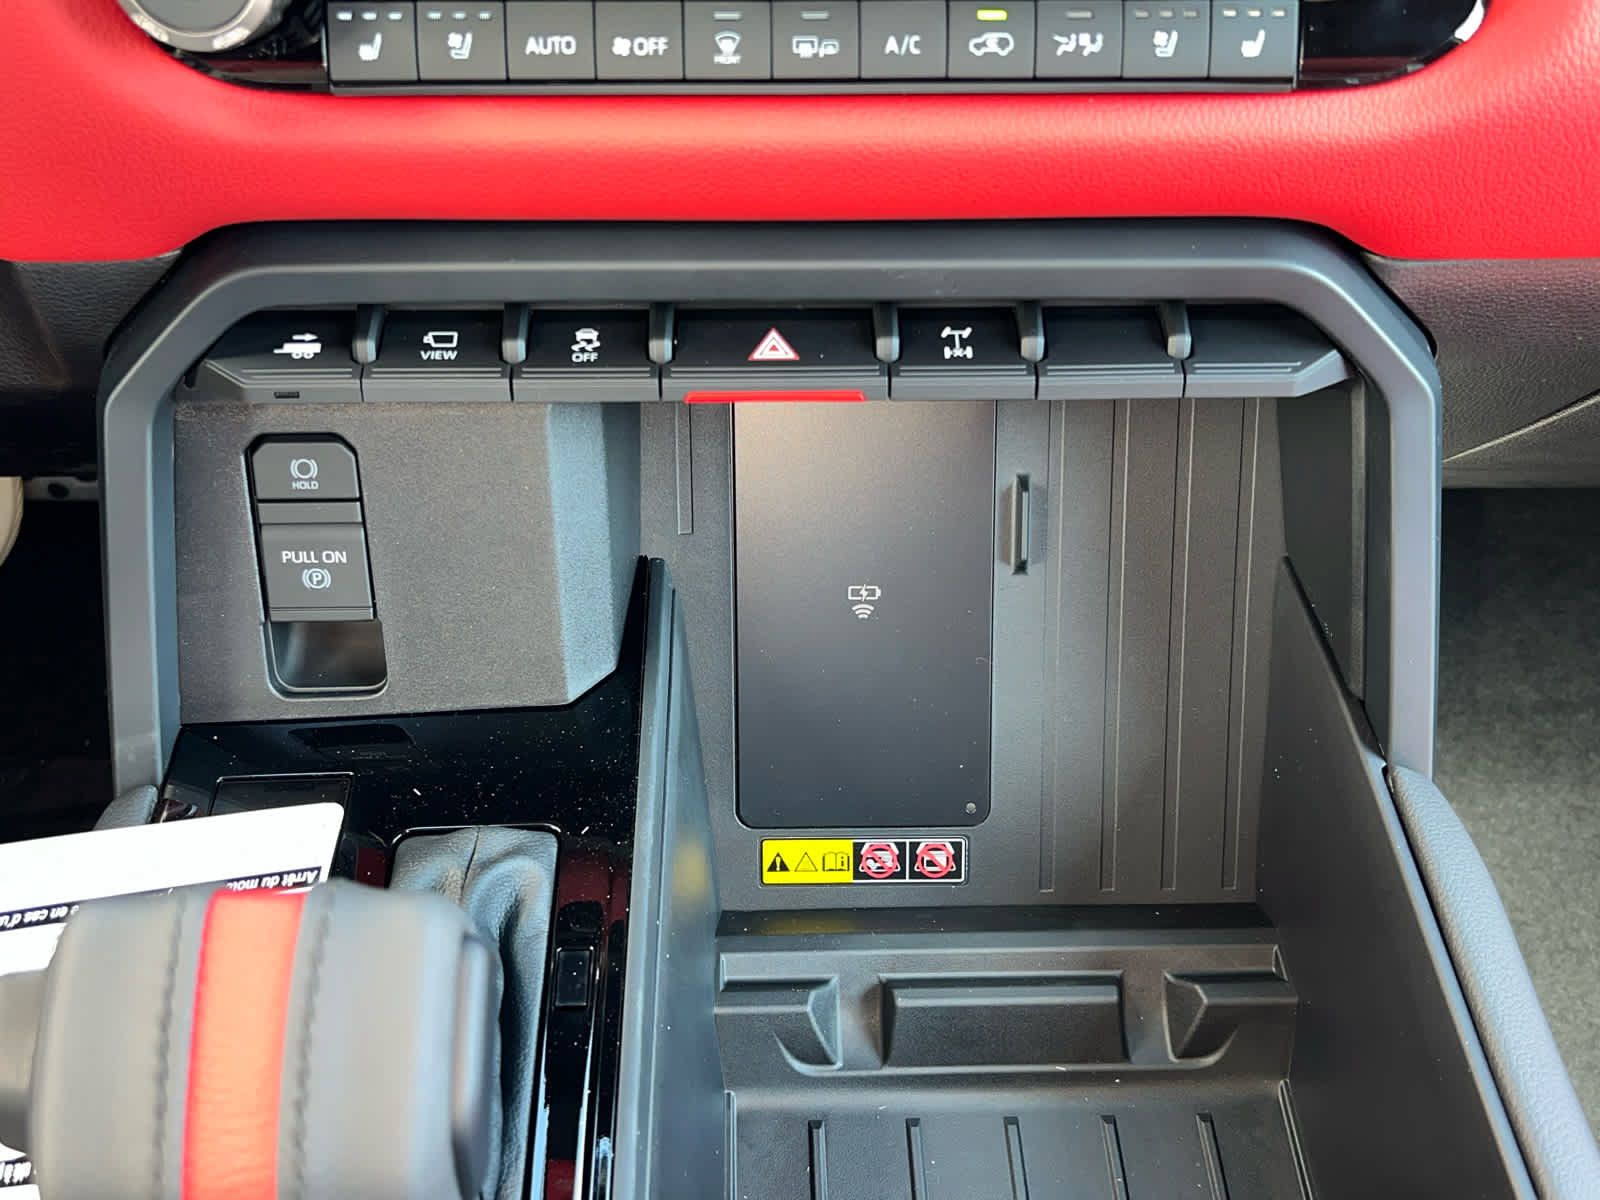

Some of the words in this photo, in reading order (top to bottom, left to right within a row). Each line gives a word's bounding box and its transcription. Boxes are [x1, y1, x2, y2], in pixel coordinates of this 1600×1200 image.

[525, 36, 577, 56] AUTO
[633, 37, 669, 57] OFF
[884, 35, 921, 55] A/C
[420, 350, 458, 361] VIEW
[571, 351, 598, 363] OFF
[292, 480, 319, 490] HOLD
[281, 550, 319, 564] PULL
[322, 550, 347, 564] ON
[261, 874, 280, 889] du
[281, 869, 319, 887] Arrêt
[24, 908, 49, 923] cas
[49, 905, 69, 919] en
